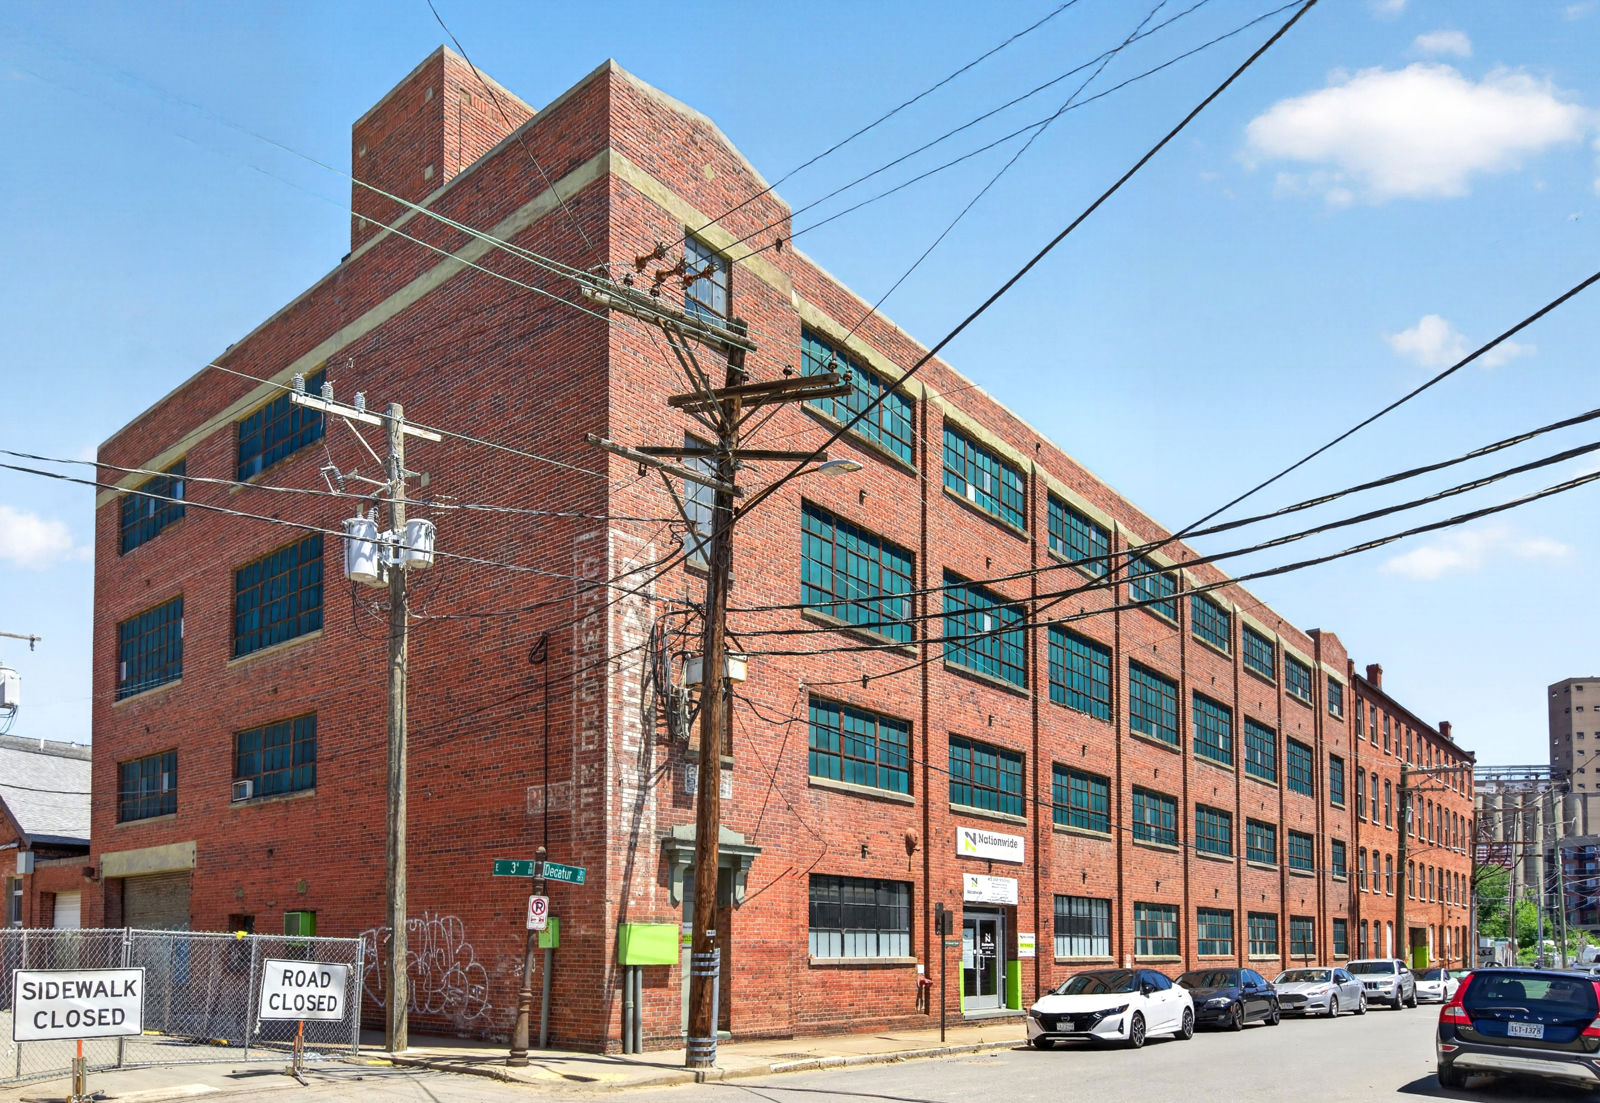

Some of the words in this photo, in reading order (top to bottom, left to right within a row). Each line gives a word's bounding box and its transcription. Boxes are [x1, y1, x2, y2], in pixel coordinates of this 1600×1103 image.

[978, 833, 1018, 848] Nationwide
[544, 863, 573, 880] Decatur
[281, 969, 331, 988] ROAD
[22, 980, 137, 1000] SIDEWALK
[269, 994, 338, 1012] CLOSED
[33, 1008, 125, 1029] CLOSED
